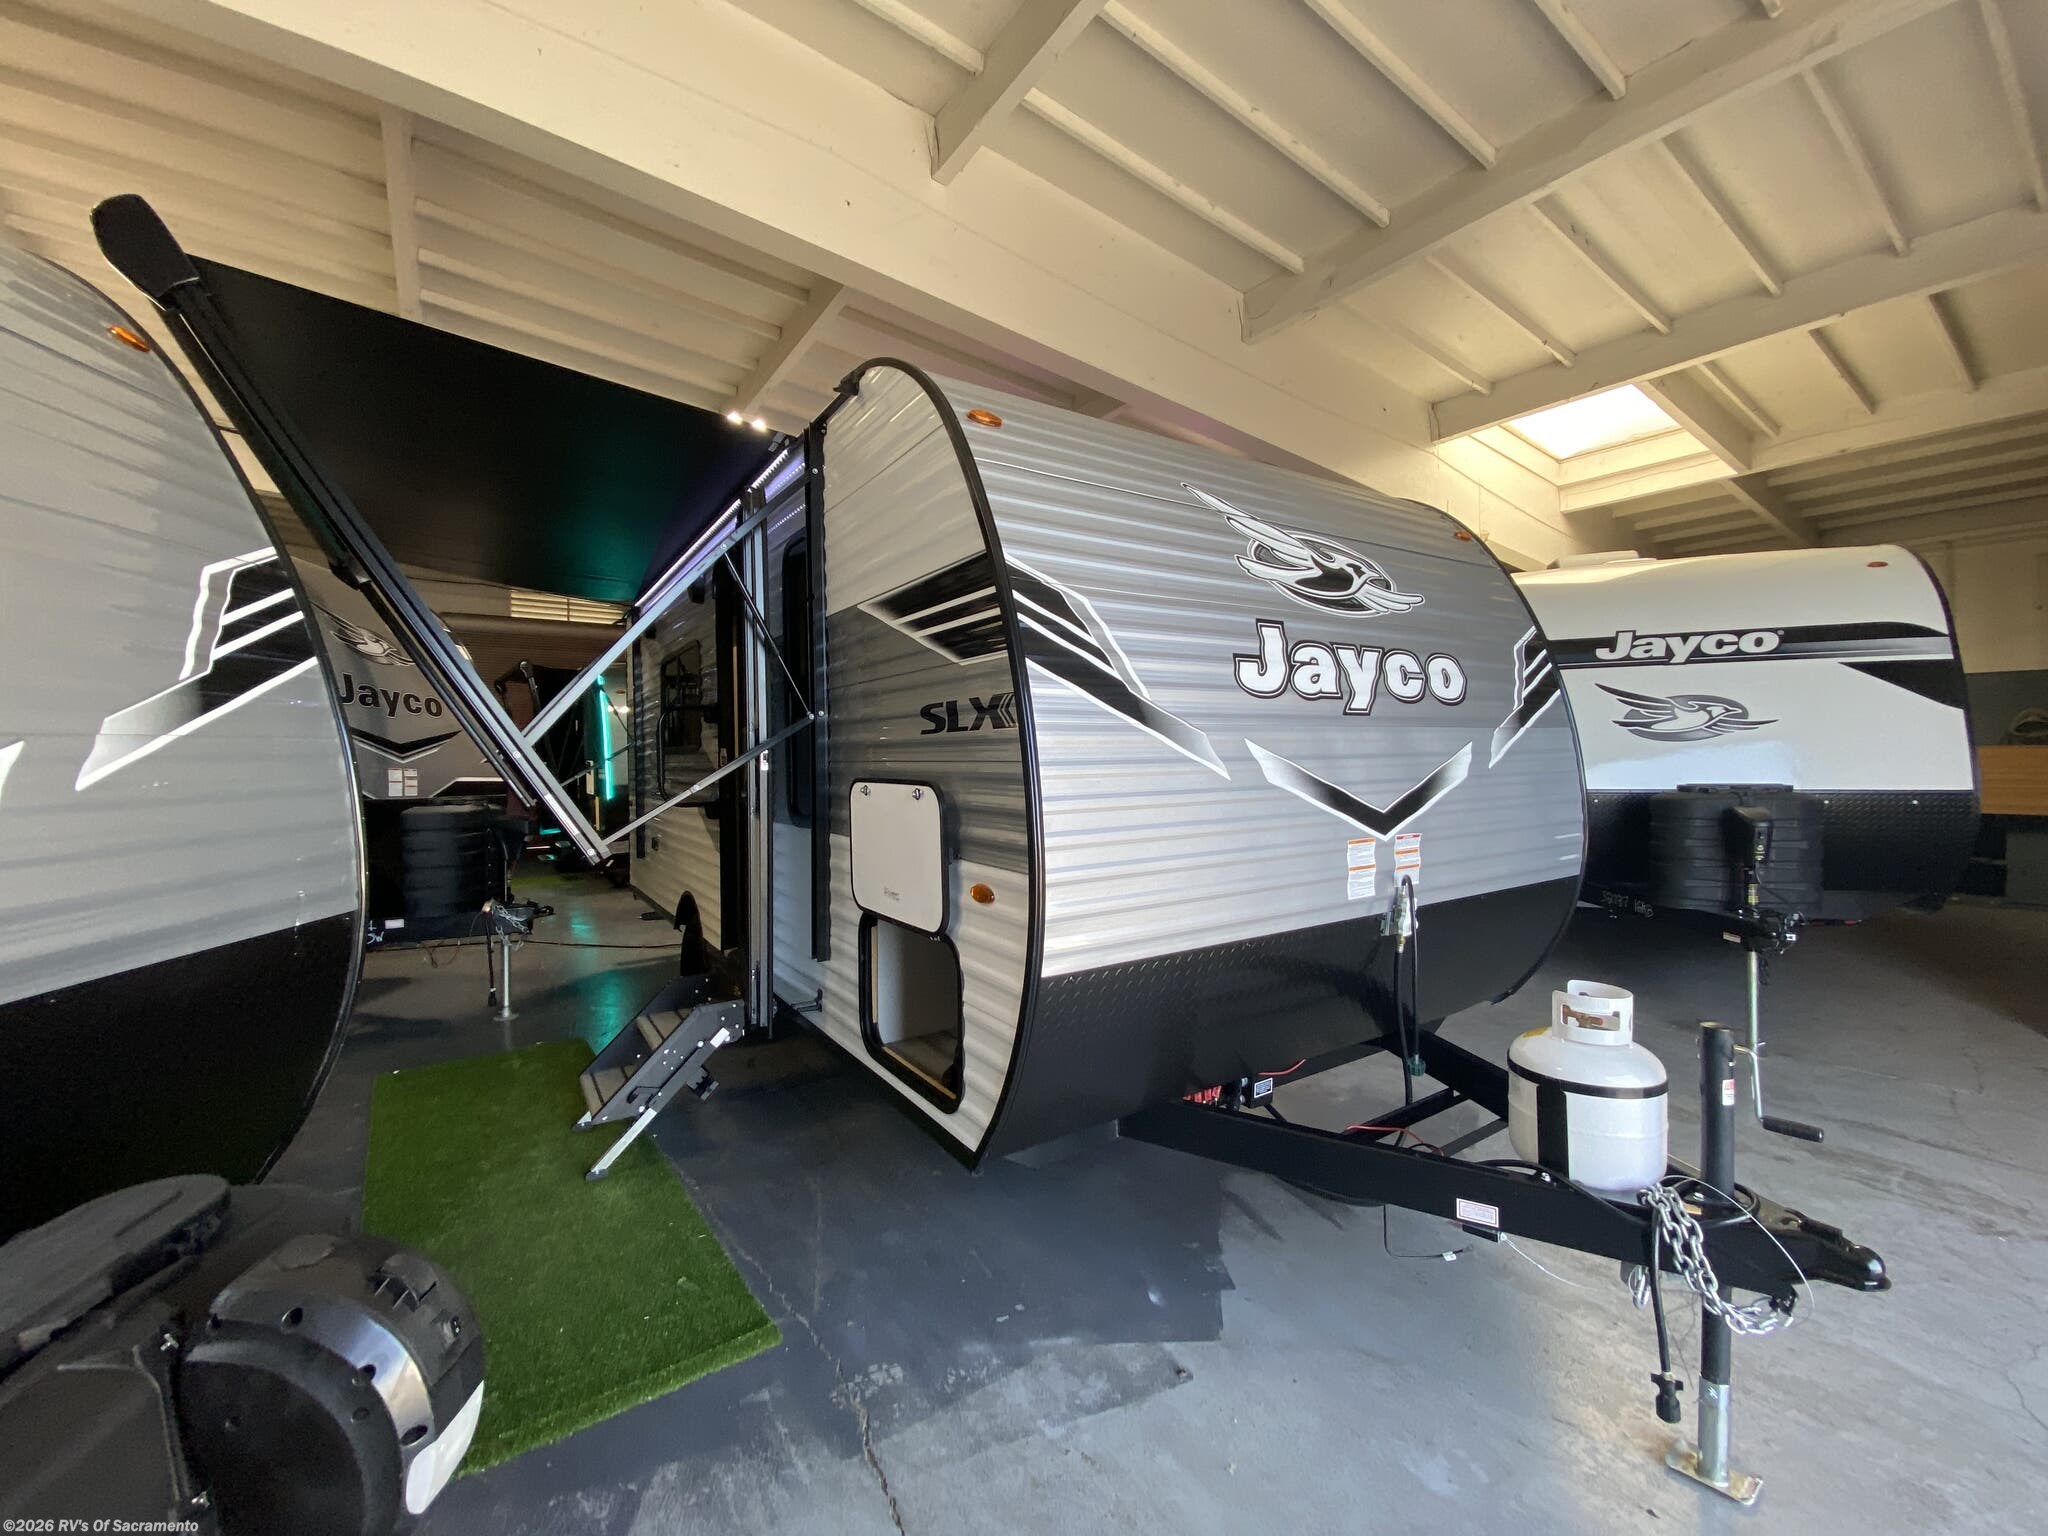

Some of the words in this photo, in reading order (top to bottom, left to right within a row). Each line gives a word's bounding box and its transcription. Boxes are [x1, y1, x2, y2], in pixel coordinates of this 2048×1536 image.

[1233, 618, 1467, 715] Jayco
[338, 673, 443, 718] Jayco
[920, 692, 1013, 734] SLX
